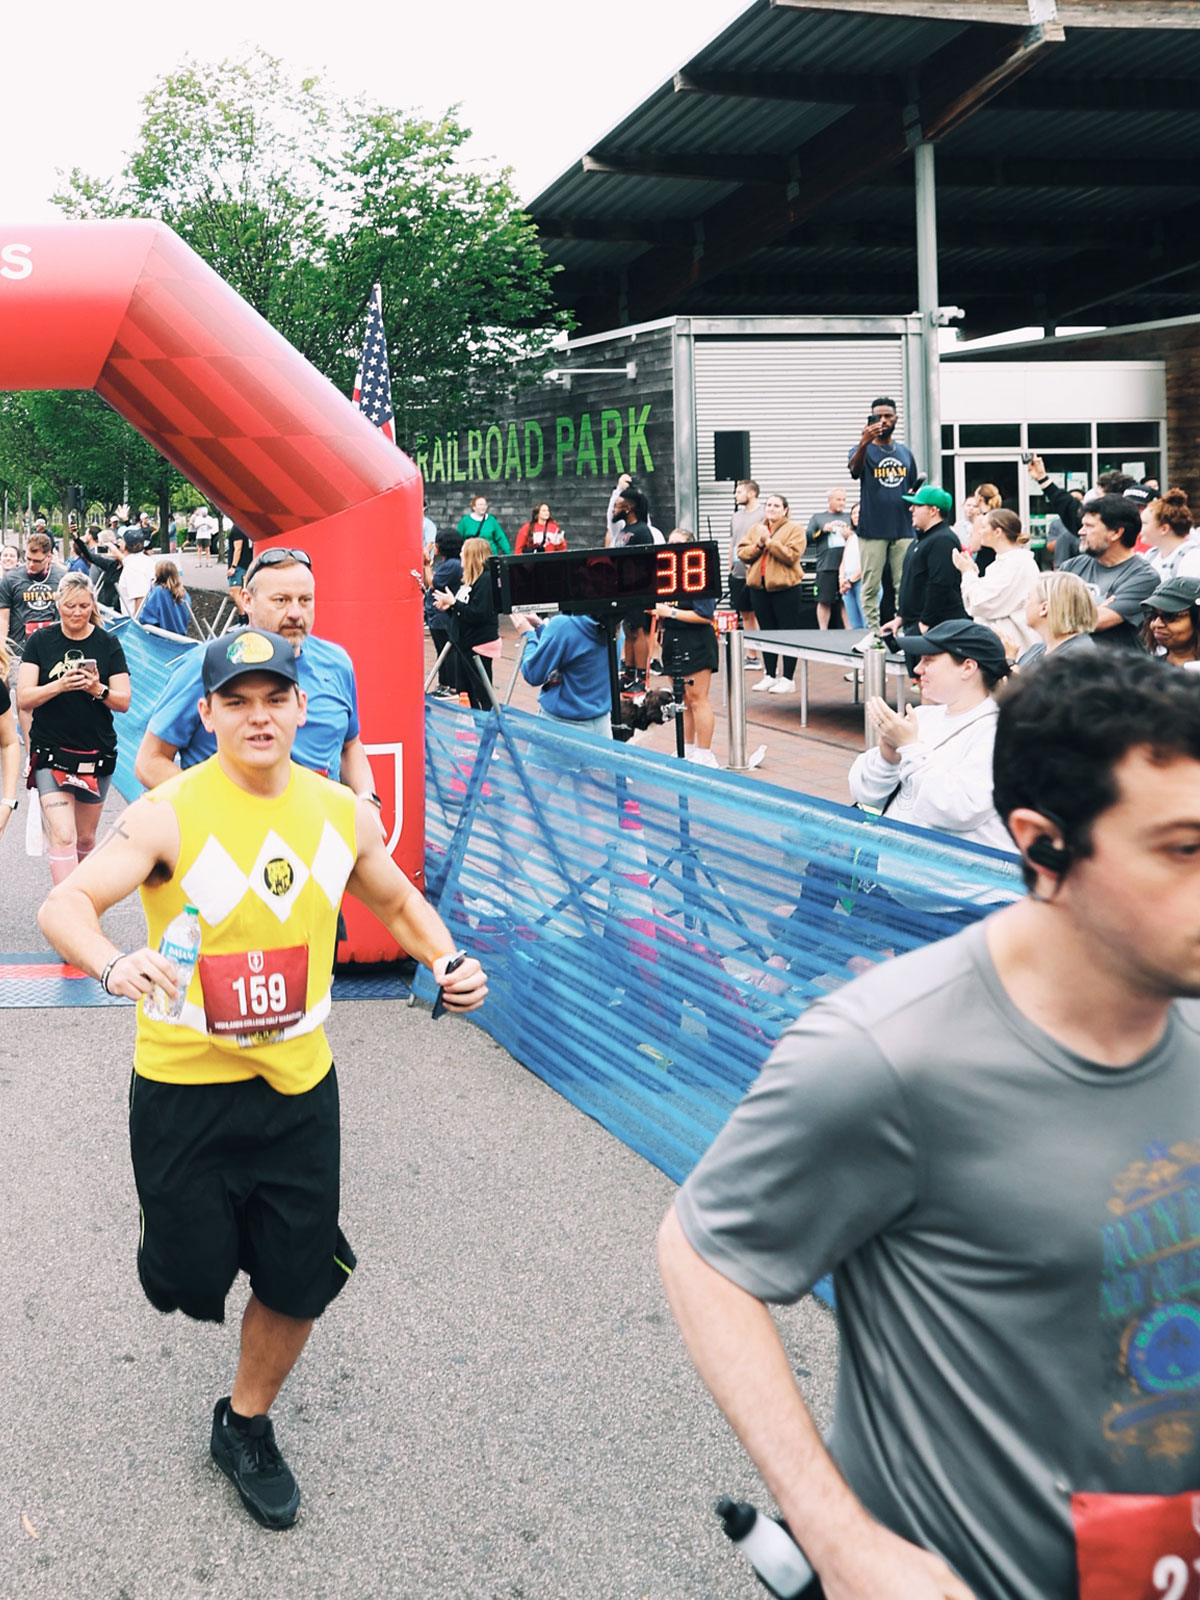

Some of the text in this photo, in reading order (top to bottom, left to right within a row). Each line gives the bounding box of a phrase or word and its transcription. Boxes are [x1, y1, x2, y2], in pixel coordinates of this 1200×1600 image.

[556, 403, 655, 477] PARK
[656, 549, 707, 595] 38
[232, 972, 287, 1017] 159
